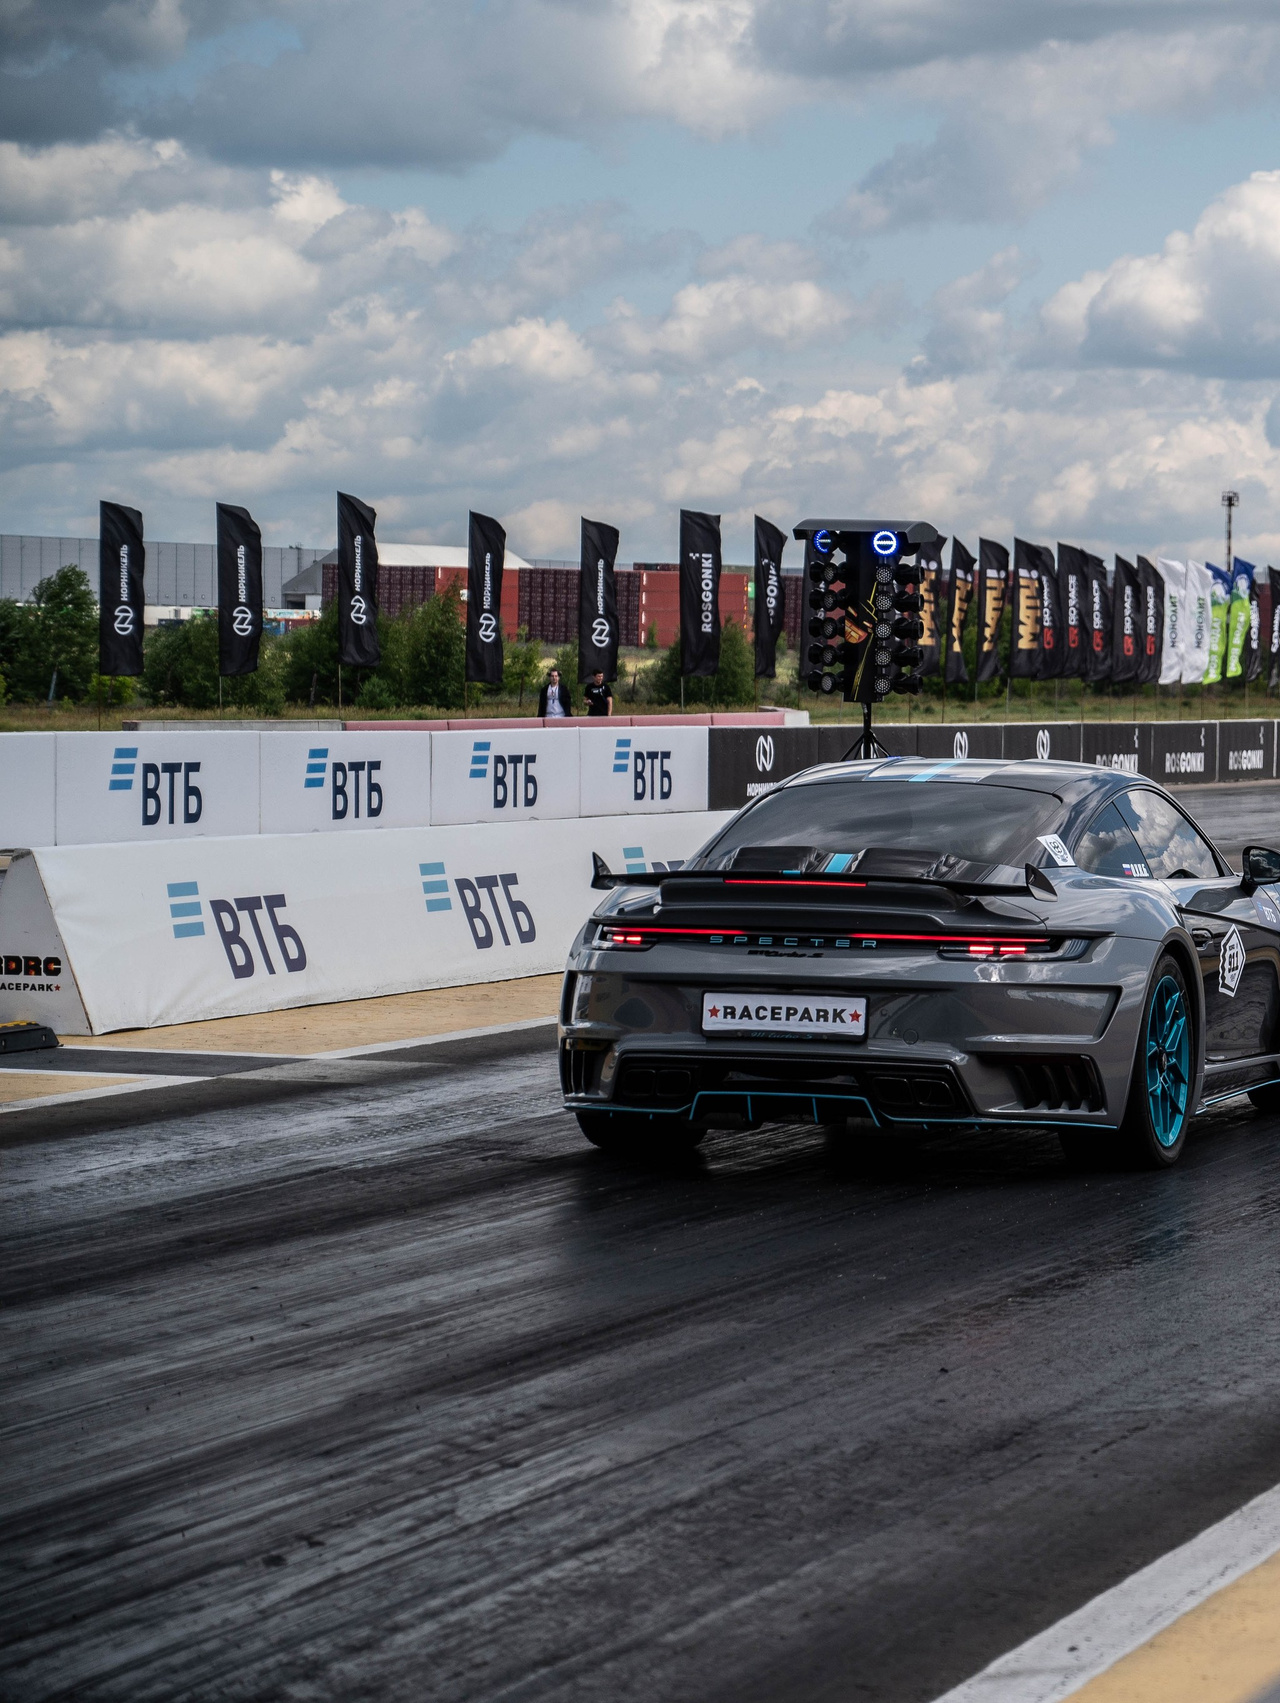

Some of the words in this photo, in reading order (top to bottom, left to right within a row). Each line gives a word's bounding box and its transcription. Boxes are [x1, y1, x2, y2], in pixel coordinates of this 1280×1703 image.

[120, 544, 128, 601] НОРНИКЕЛЬ
[237, 545, 246, 602] НОРНИКЕЛЬ
[354, 535, 362, 591] НОРНИКЕЛЬ
[483, 552, 491, 609] НОРНИКЕЛЬ
[701, 553, 712, 633] ROSGONKI
[493, 754, 538, 808] ВТБ
[633, 750, 672, 801] ВТБ
[1165, 752, 1204, 773] ROSGONKI
[1228, 749, 1264, 770] ROSGONKI
[141, 761, 203, 826] ВТБ
[331, 760, 383, 820] ВТБ
[209, 893, 308, 979] ВТБ
[454, 873, 537, 950] ВТБ
[0, 955, 61, 976] DRC
[709, 935, 877, 948] SPECTER
[1228, 950, 1239, 974] 911
[723, 1005, 847, 1023] RACEPARK
